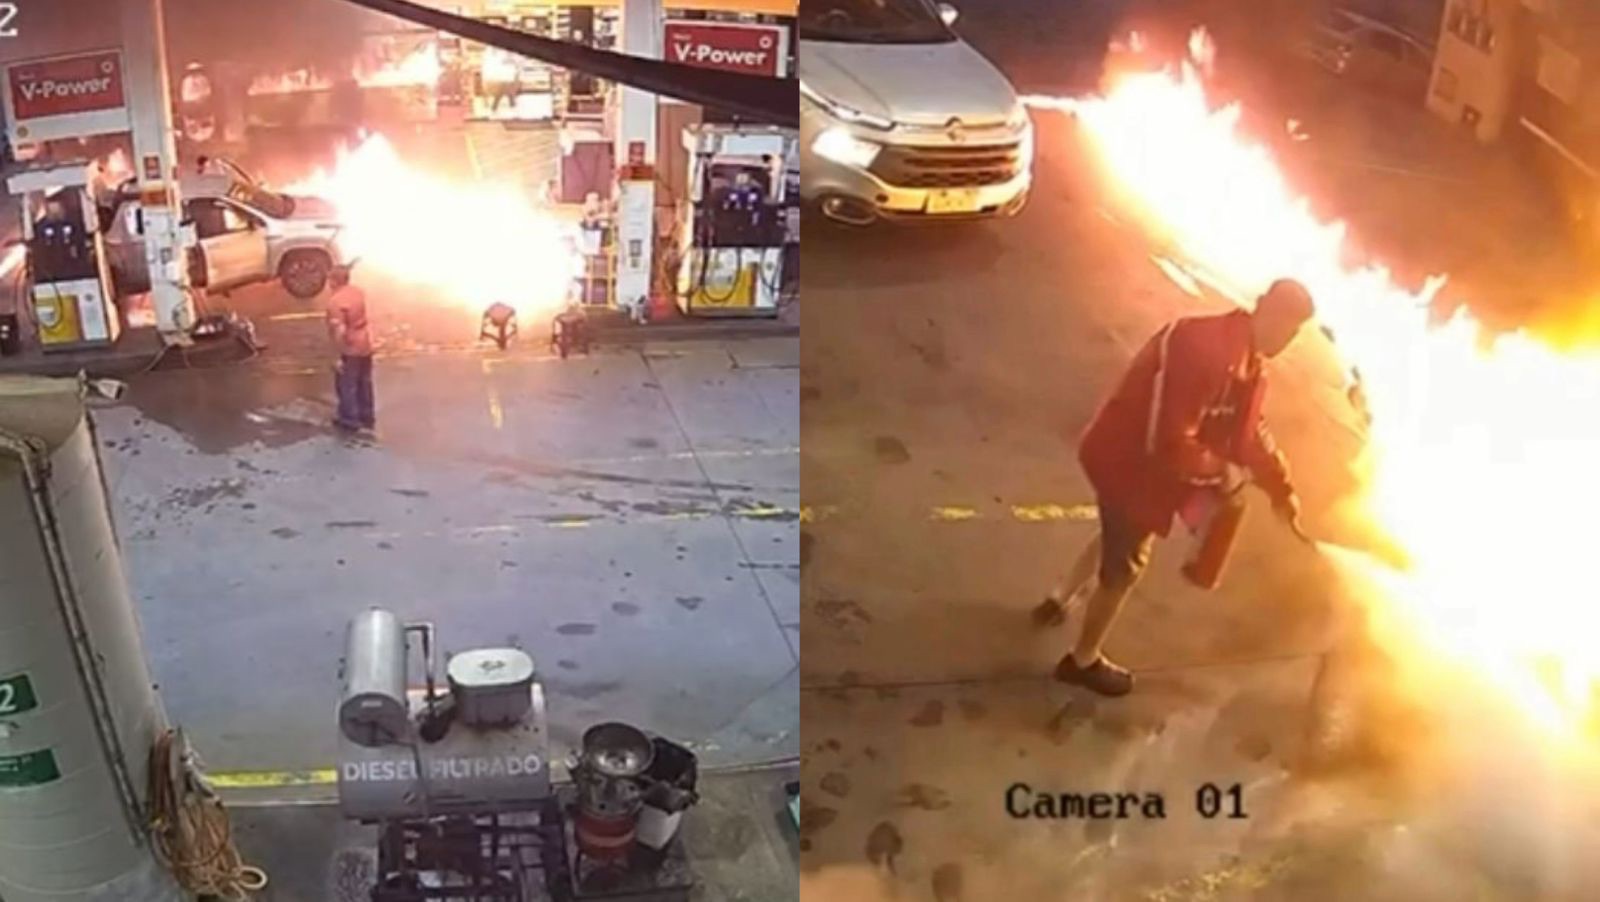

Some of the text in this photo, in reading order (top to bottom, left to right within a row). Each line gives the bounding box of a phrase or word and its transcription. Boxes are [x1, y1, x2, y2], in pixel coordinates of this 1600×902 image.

[674, 43, 767, 65] V-Power
[20, 77, 111, 101] V-Power
[0, 683, 17, 711] 2
[431, 754, 541, 779] FILTRADO
